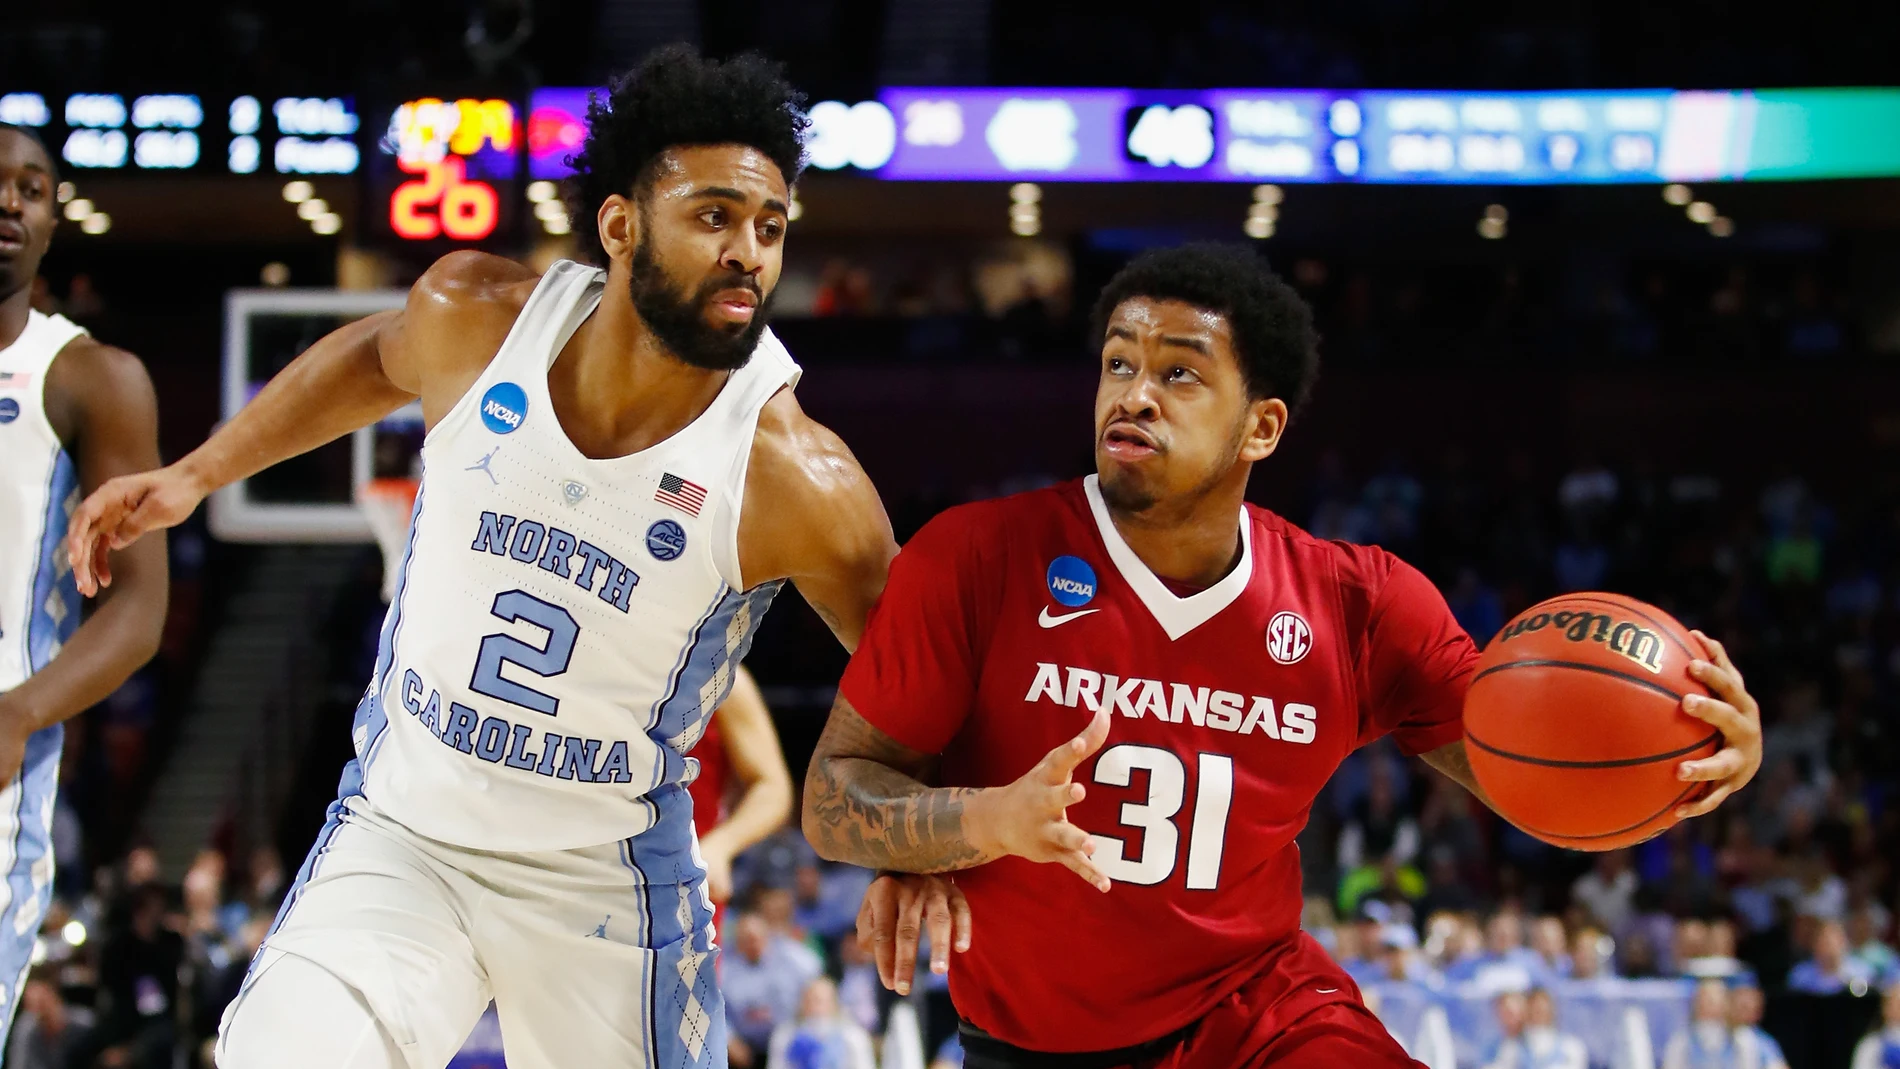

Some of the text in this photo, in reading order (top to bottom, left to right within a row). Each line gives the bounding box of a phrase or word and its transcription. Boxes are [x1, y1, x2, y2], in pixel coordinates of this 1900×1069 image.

[1128, 104, 1214, 169] 46
[391, 152, 498, 239] 26
[483, 399, 521, 428] NCAA
[471, 511, 640, 614] NORTH
[653, 532, 684, 548] ACC
[1052, 576, 1093, 597] NCAA
[468, 589, 581, 717] 2
[1270, 615, 1309, 661] SEC
[1501, 610, 1666, 675] Wilson
[401, 668, 633, 783] CAROLINA
[1024, 662, 1317, 745] ARKANSAS
[1088, 742, 1235, 891] 31
